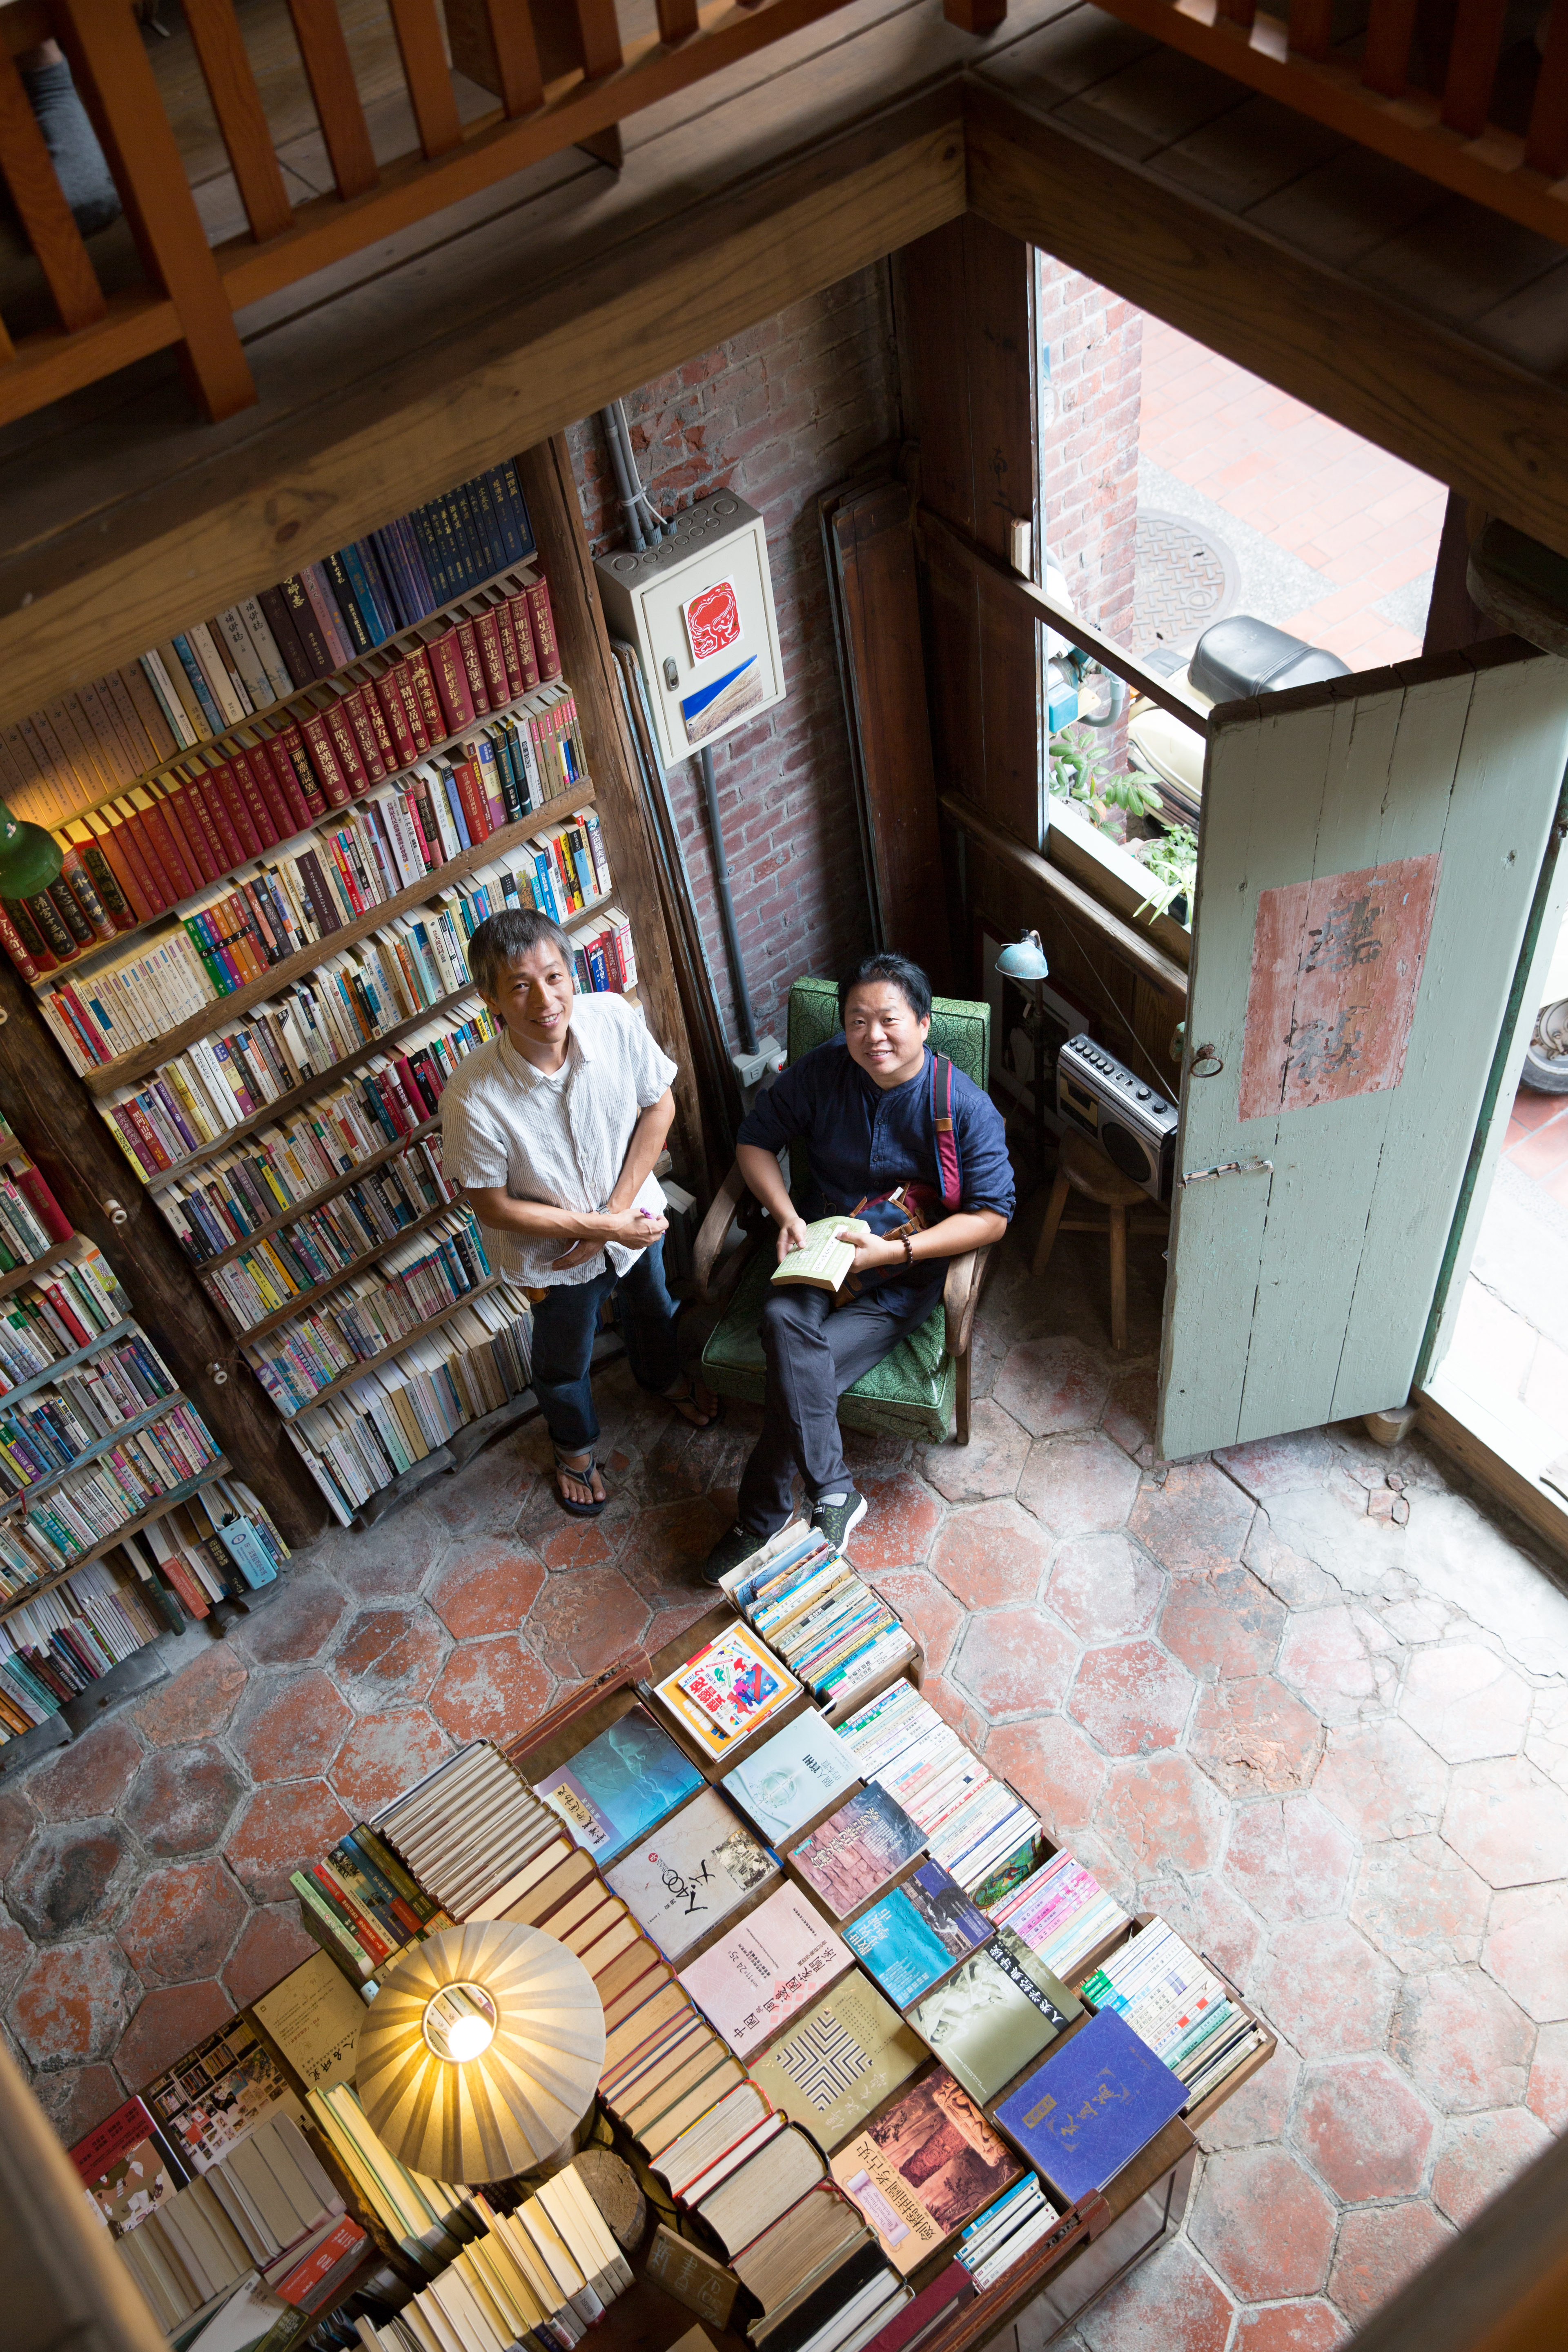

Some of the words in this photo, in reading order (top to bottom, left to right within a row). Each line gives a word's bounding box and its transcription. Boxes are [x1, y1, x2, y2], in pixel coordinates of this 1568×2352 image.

[493, 479, 503, 503] 經濟篇
[506, 471, 518, 497] 地理篇
[501, 628, 519, 673] 朱洪武演義
[515, 618, 534, 665] 明史演義
[537, 608, 555, 655] 唐史演義
[463, 646, 484, 692] 元史演義
[483, 637, 504, 684] 清史演義
[417, 677, 438, 720] 續金瓶梅
[443, 659, 464, 711] 民國史演義
[389, 699, 407, 740] 水滸傳
[400, 685, 422, 731] 精忠岳傳
[369, 706, 391, 750] 七俠五義
[314, 741, 340, 786] 後漢演義
[334, 729, 360, 773] 隋唐演義
[292, 748, 318, 795] 聊齋誌異
[592, 830, 606, 865] 戈巴契夫傳
[158, 1083, 173, 1106] INTRODUCING
[132, 1112, 154, 1141] 黑門山路
[688, 1674, 726, 1713] 雙響炮
[732, 1711, 743, 1723] Konica
[810, 1711, 826, 1728] Reality
[822, 1724, 840, 1745] Personal
[802, 1752, 834, 1790] 個人實相
[820, 1757, 842, 1782] 的本質
[839, 1744, 854, 1761] Nature
[554, 1783, 608, 1846] 臺灣美術運動史
[581, 1796, 601, 1820] 謝里法著
[808, 1805, 882, 1872] 台灣文學的歷史考察
[848, 1906, 893, 1947] 世界城市
[855, 1923, 892, 1956] 散步學
[989, 1943, 1063, 2025] 人类学经典导读
[1019, 1962, 1036, 1982] Anthropology
[1034, 1980, 1053, 2000] Understanding
[307, 2037, 358, 2082] 人名研究
[1054, 2082, 1120, 2139] 交通篇
[853, 2139, 937, 2243] 劍橋插圖考古史
[861, 2194, 881, 2218] Cambridge
[864, 2190, 879, 2207] History
[871, 2191, 893, 2216] Archaeology
[876, 2206, 893, 2227] Illustrated
[878, 2216, 886, 2226] The
